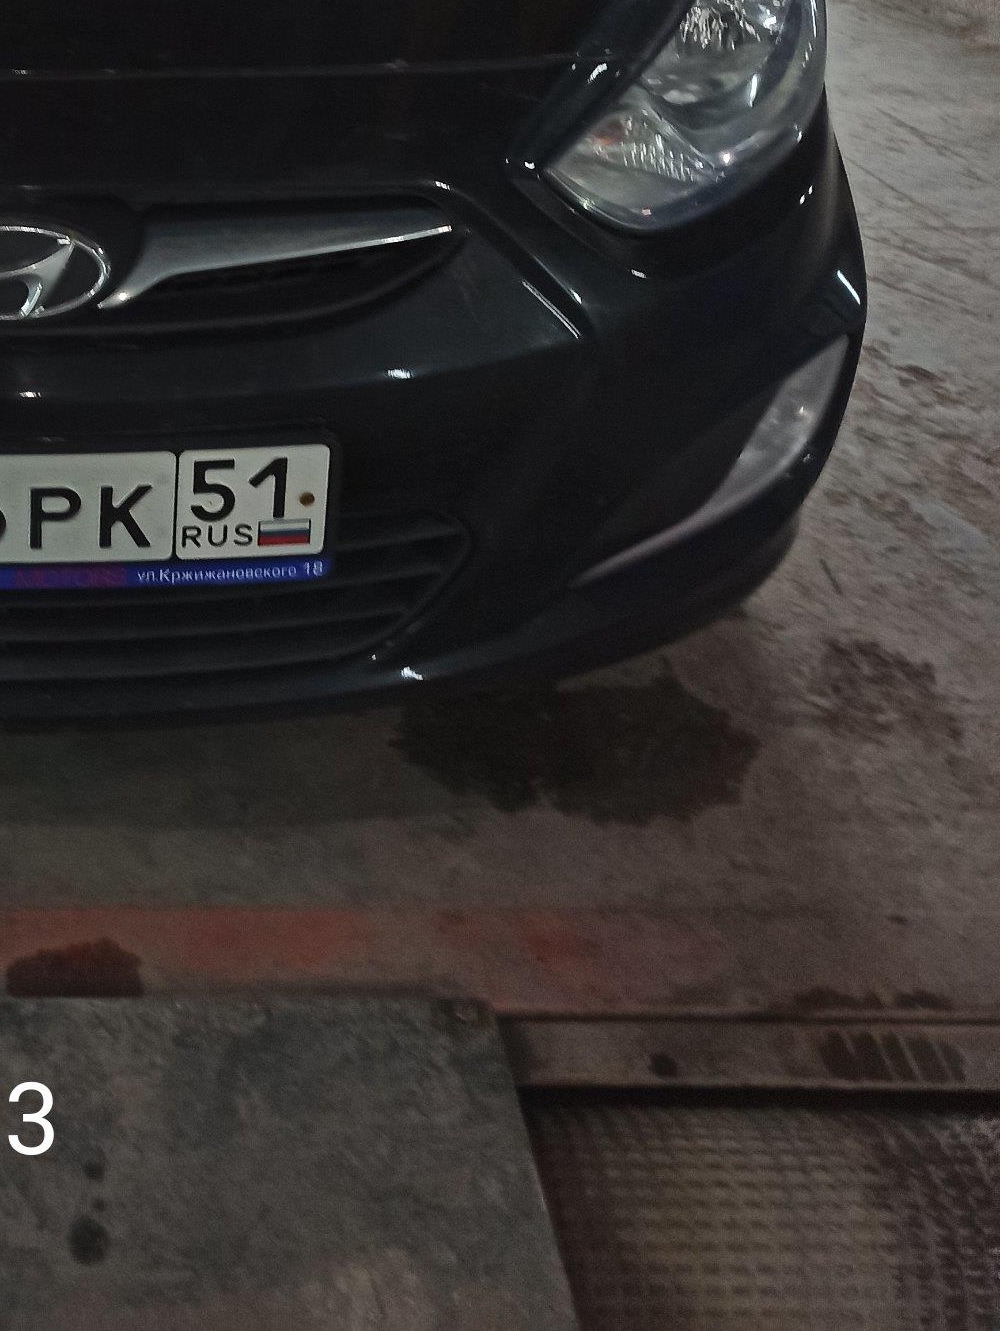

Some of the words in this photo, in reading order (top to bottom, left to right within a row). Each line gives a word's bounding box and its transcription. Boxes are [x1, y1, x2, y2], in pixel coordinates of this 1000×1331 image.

[190, 456, 289, 522] 51
[181, 523, 253, 548] RUS
[304, 560, 323, 577] 18
